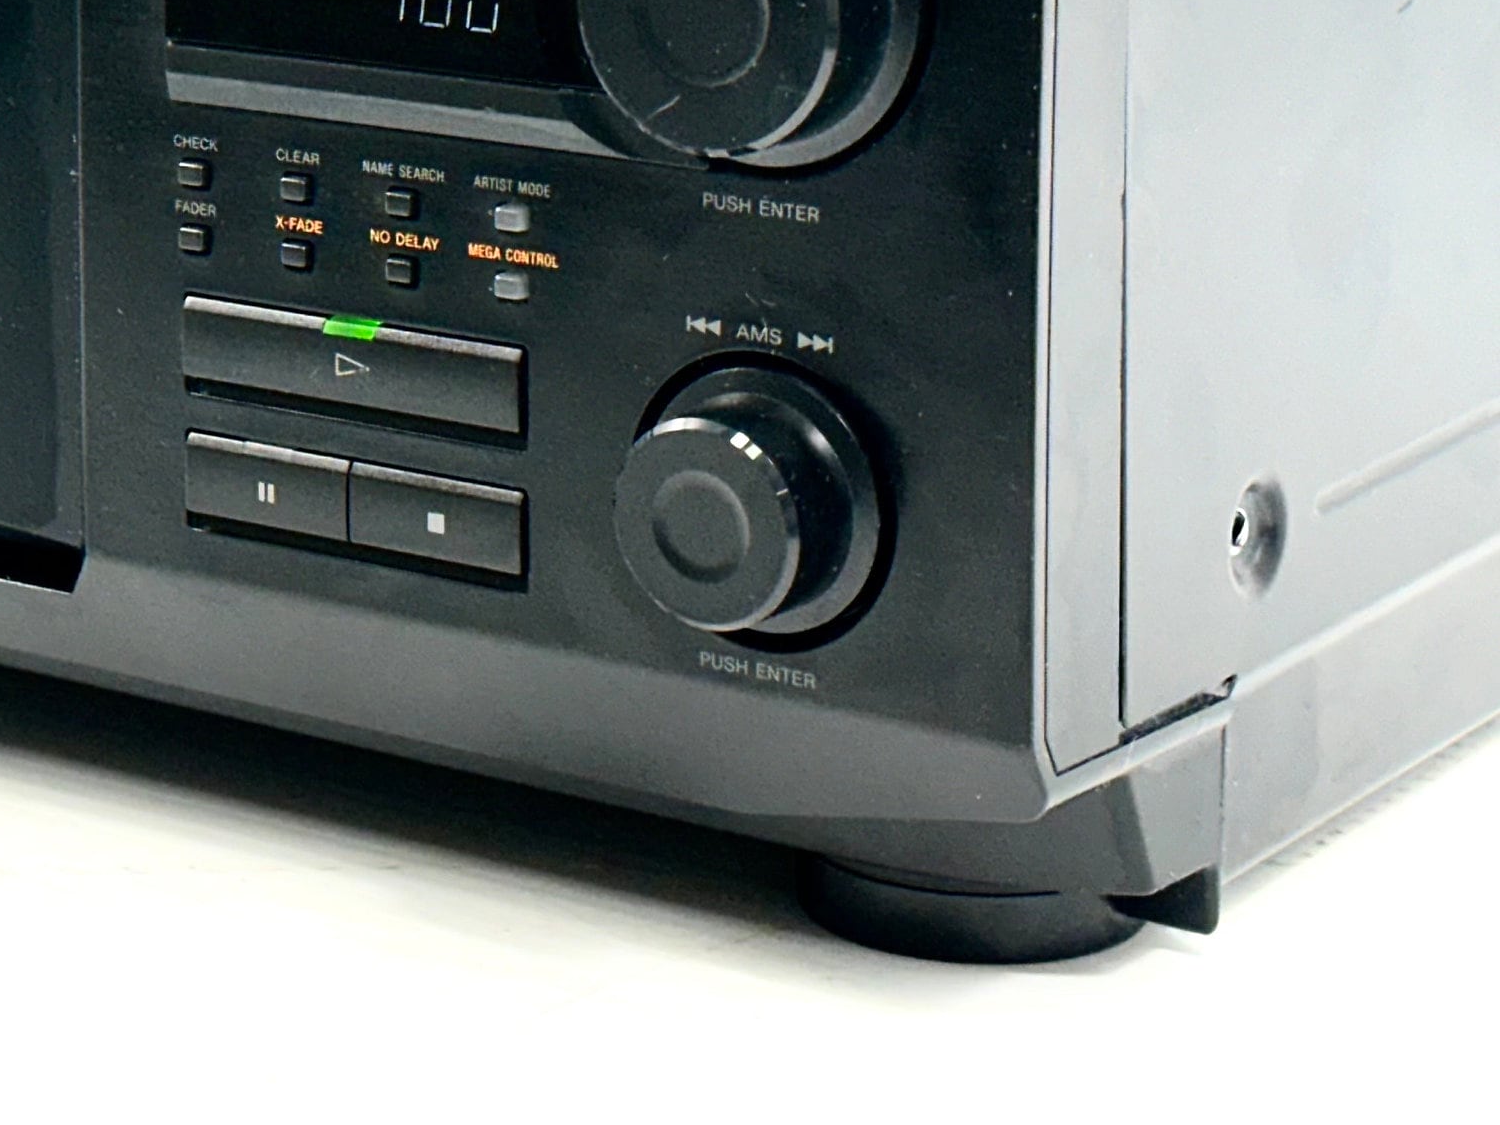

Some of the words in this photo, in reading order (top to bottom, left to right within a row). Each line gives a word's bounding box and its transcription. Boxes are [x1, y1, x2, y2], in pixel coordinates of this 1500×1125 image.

[173, 134, 218, 153] CHECK
[276, 148, 320, 166] CLEAR
[362, 160, 394, 177] NAME
[399, 164, 445, 183] SEARCH
[473, 175, 514, 192] ARTIST
[517, 181, 551, 199] MODE
[175, 198, 217, 218] FADER
[702, 191, 751, 214] PUSH
[759, 199, 820, 223] ENTER
[275, 215, 324, 235] X-FADE
[370, 228, 391, 244] NO
[396, 232, 440, 252] DELAY
[468, 241, 500, 261] MEGA
[505, 248, 560, 269] CONTROL
[736, 324, 782, 346] AMS
[700, 651, 749, 675] PUSH
[756, 663, 817, 689] ENTER
